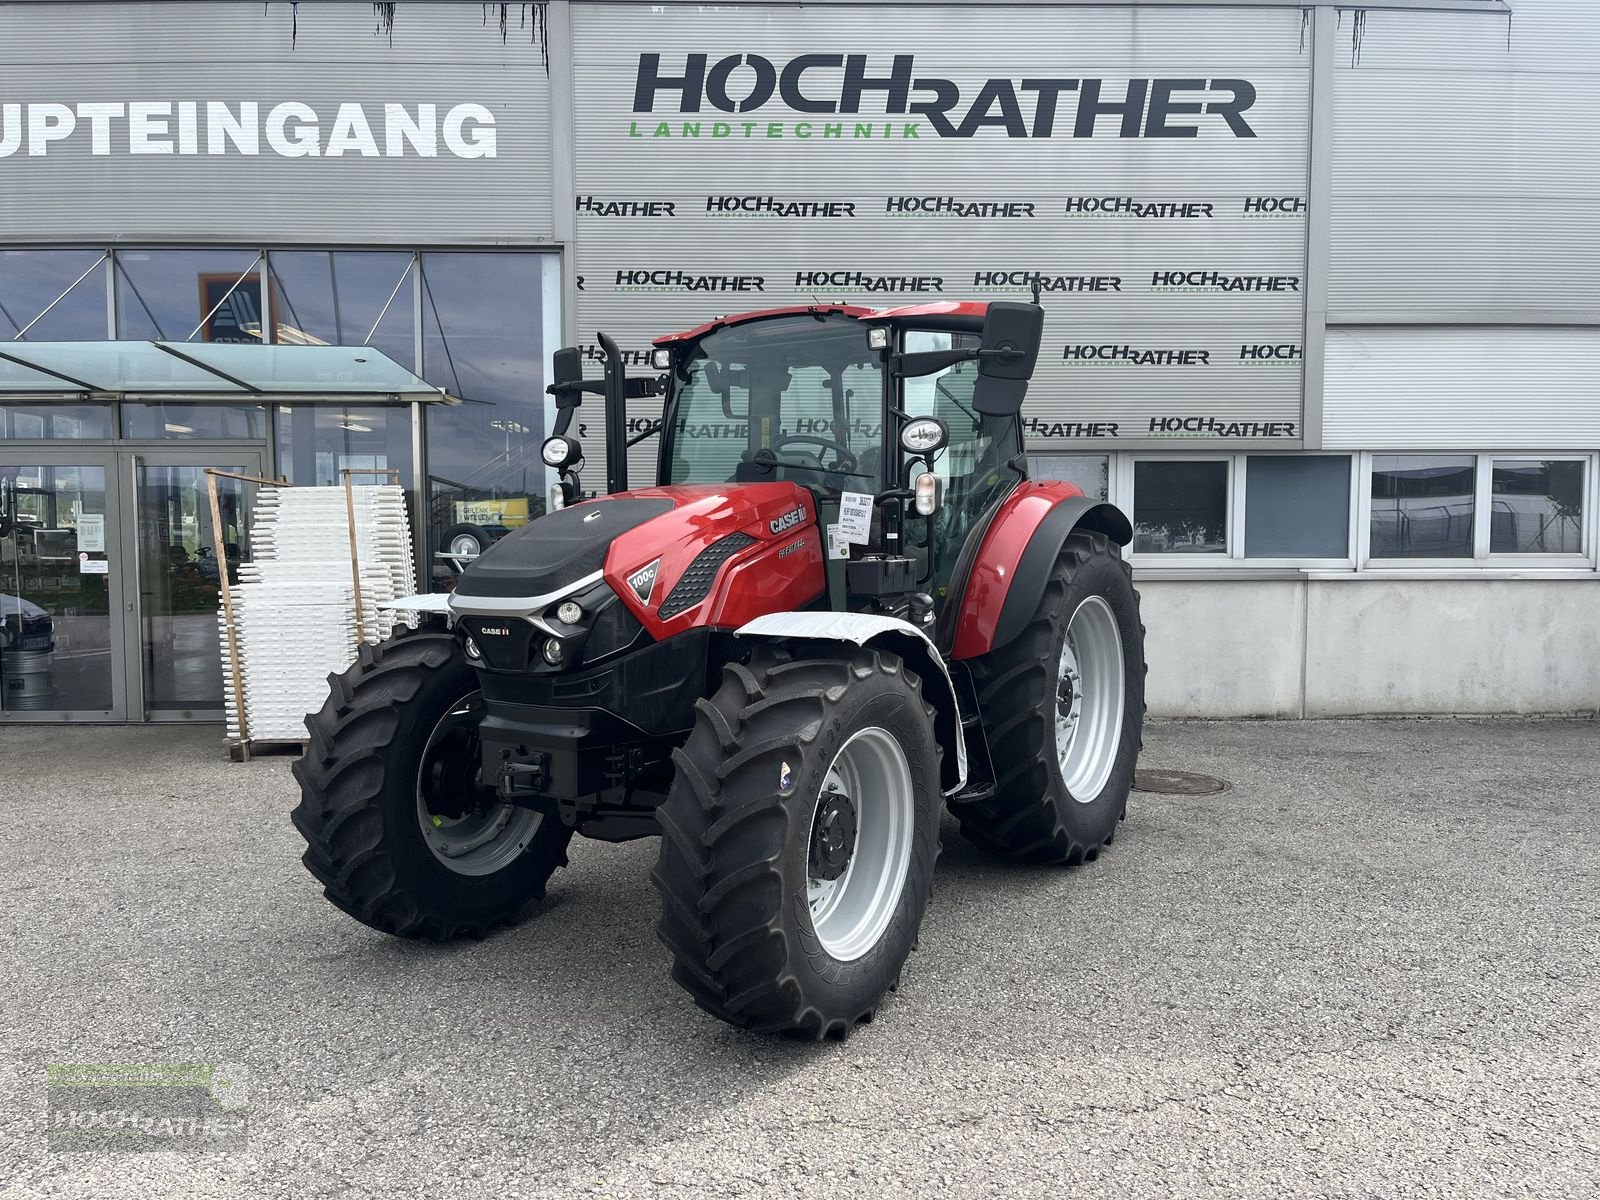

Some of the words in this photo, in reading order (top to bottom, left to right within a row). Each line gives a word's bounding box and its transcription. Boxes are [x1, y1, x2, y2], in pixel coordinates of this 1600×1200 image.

[632, 53, 1257, 138] HOCHRATHER
[629, 122, 920, 138] LANDTECHNIK
[706, 196, 856, 218] HOCHRATHER
[885, 197, 1036, 218] HOCHRATHER
[1065, 197, 1214, 218] HOCHRATHER
[615, 270, 766, 292] HOCHRATHER
[794, 271, 944, 292] HOCHRATHER
[973, 271, 1122, 292] HOCHRATHER
[1151, 271, 1300, 292] HOCHRATHER
[1063, 345, 1210, 365] HOCHRATHER
[1149, 417, 1296, 437] HOCHRATHER
[770, 510, 799, 534] CASE
[481, 627, 501, 635] CASE
